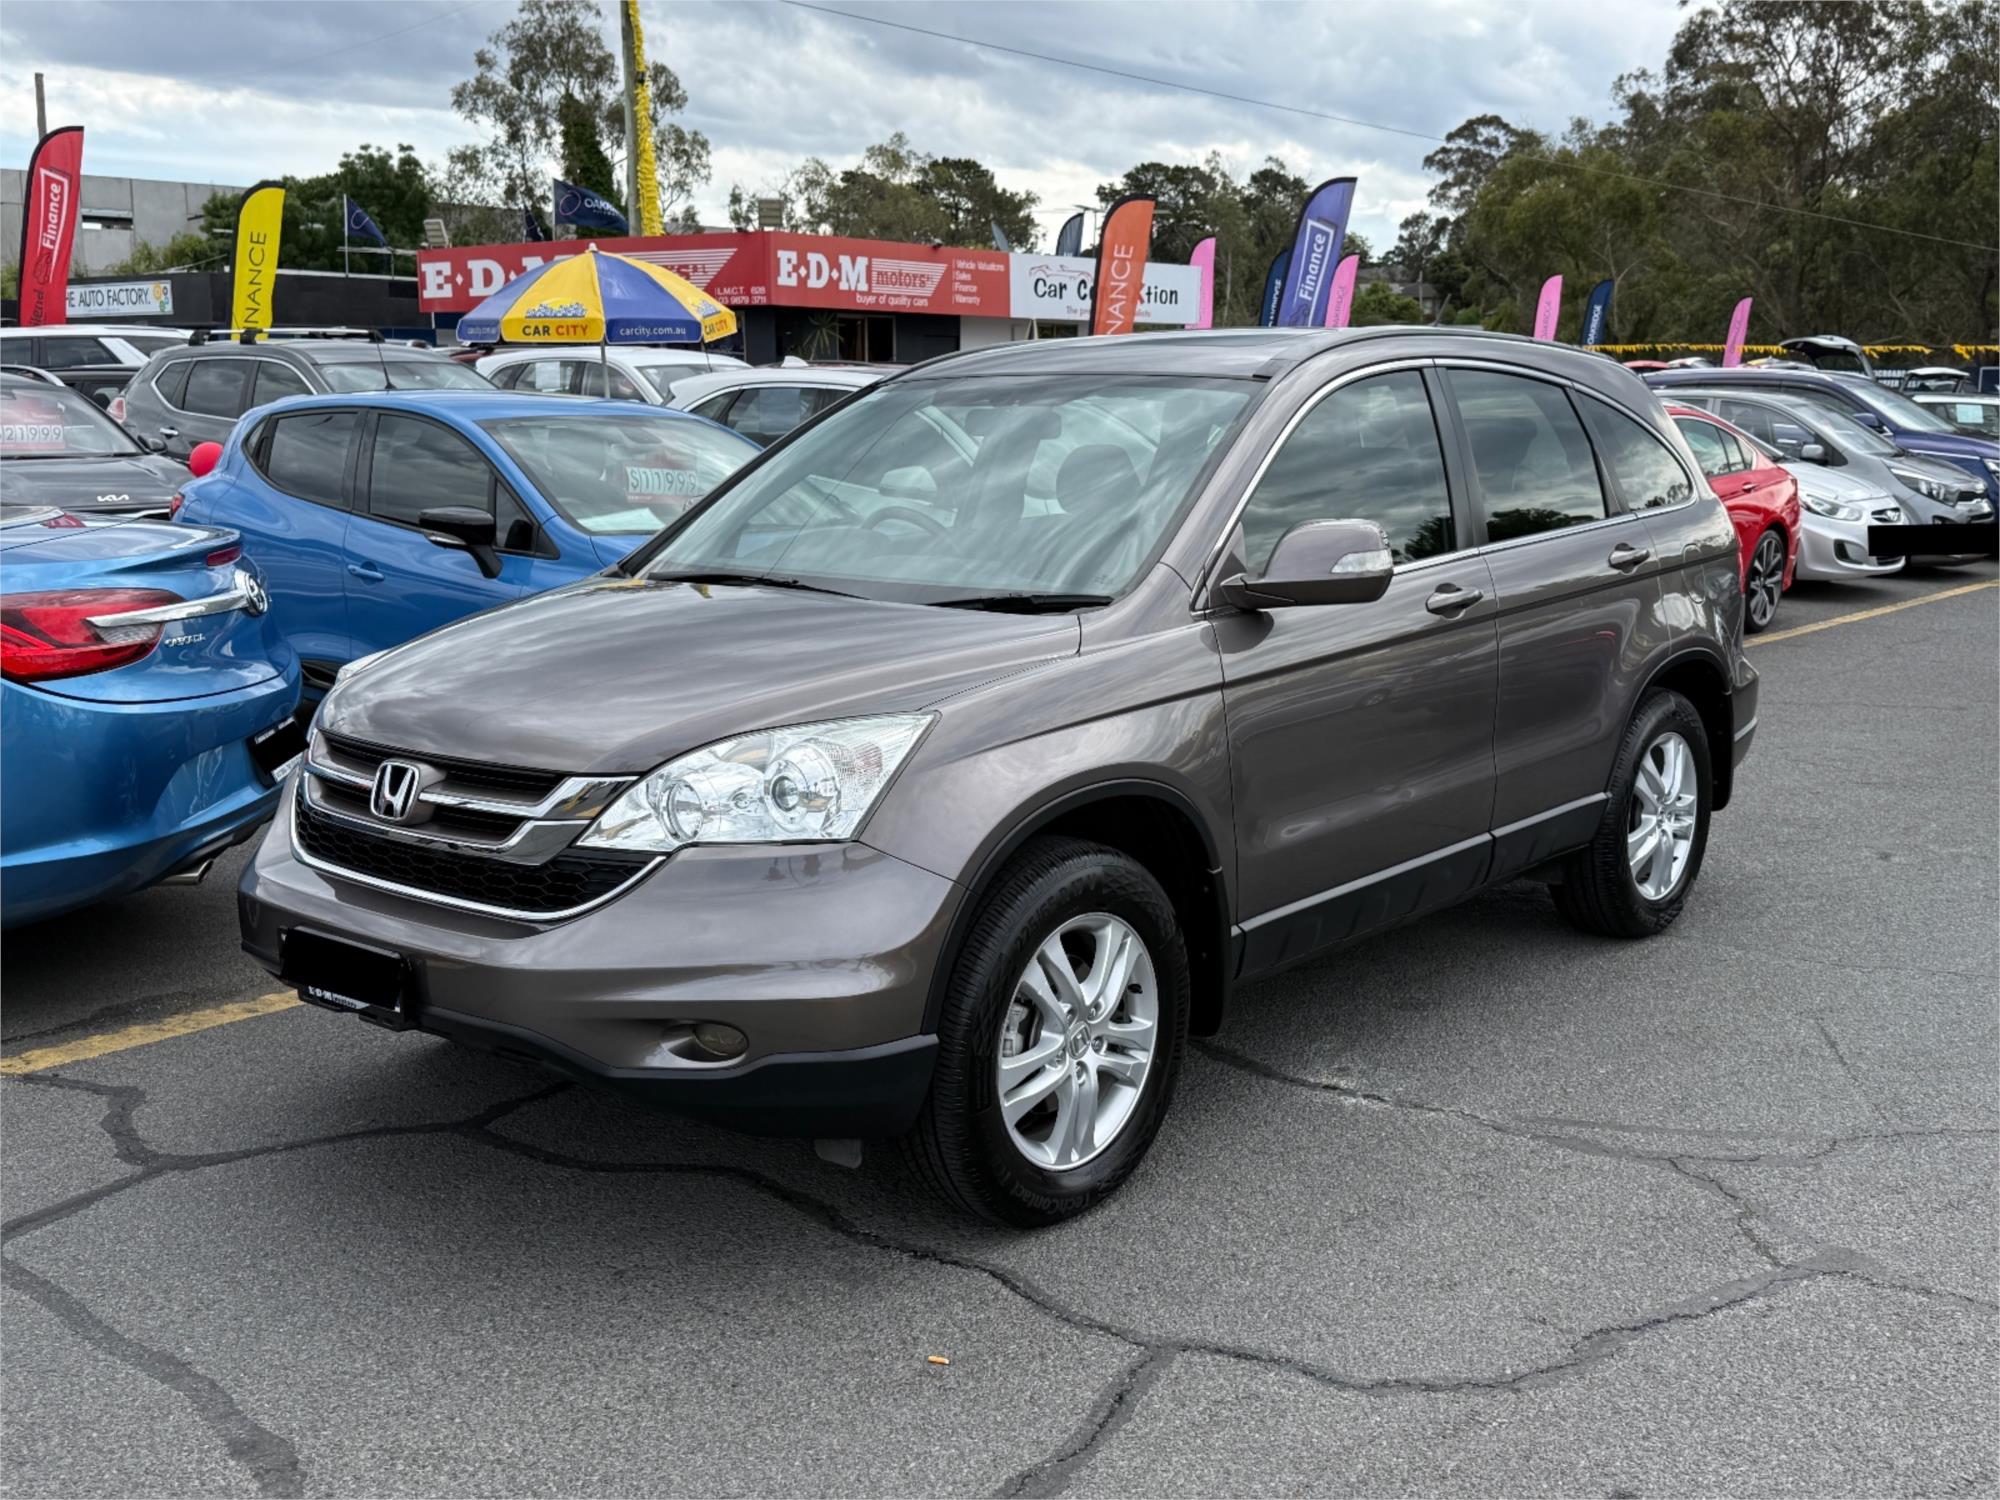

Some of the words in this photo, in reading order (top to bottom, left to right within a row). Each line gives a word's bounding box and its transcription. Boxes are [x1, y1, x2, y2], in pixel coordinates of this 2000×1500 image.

[42, 182, 63, 250] Finance
[1298, 232, 1327, 301] Finance
[242, 231, 267, 330] INANCE
[1033, 277, 1067, 300] Car
[1106, 244, 1134, 335] NANCE
[78, 289, 105, 307] AUTO
[856, 292, 877, 306] buyer
[879, 295, 887, 305] of
[888, 296, 911, 309] quality
[912, 298, 928, 307] cars
[522, 324, 551, 337] CAR
[555, 324, 589, 337] CITY
[619, 325, 687, 337] carcity.com.au
[0, 426, 62, 442] 21999
[630, 469, 697, 493] $11999
